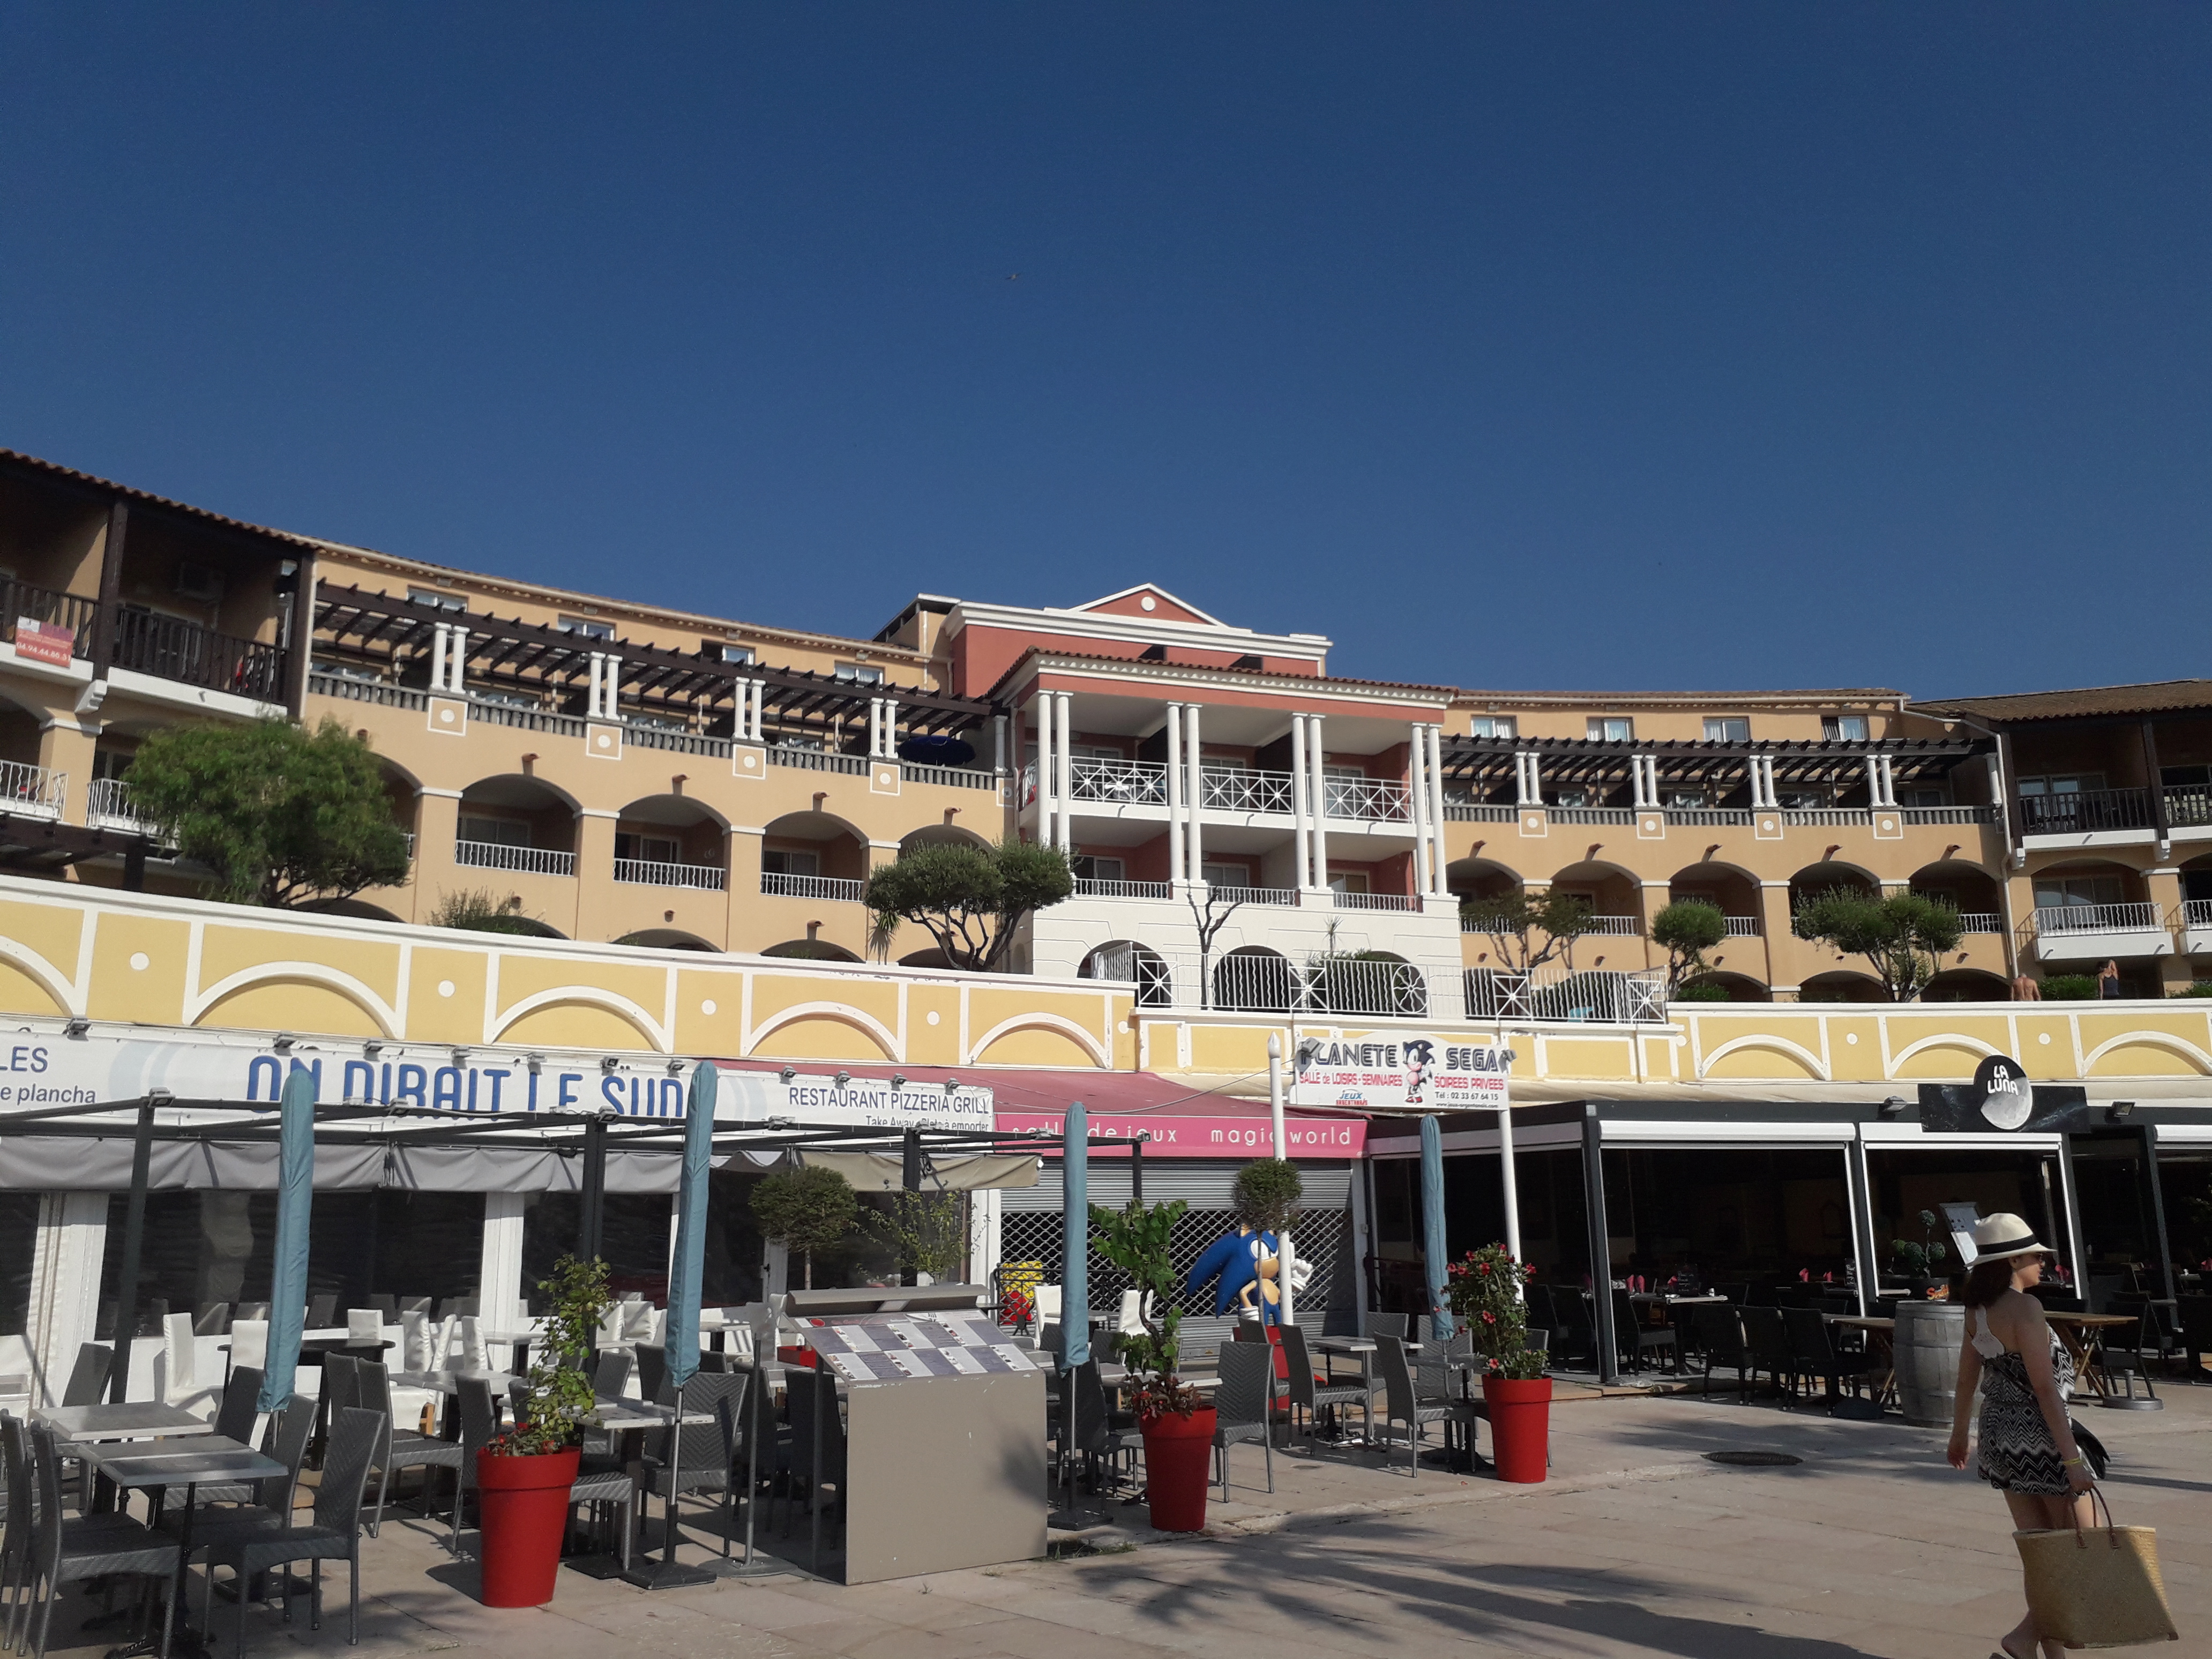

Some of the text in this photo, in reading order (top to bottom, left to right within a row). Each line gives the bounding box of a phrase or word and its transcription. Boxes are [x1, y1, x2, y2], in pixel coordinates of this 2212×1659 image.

[1301, 1042, 1499, 1072] LANETE SEGA
[1299, 1072, 1403, 1087] SALLE de LOISIRS SEMINAIRES
[1993, 1065, 2009, 1079] LA
[1434, 1075, 1504, 1090] SOIREES PRIVEES
[1987, 1079, 2019, 1096] LUNA
[17, 1082, 96, 1106] plancha
[789, 1087, 989, 1114] RESTAURANT PIZZERIA GRILL
[1339, 1090, 1363, 1100] JEUX
[1461, 1092, 1469, 1100] 33
[865, 1115, 888, 1126] Take
[890, 1116, 911, 1127] Away
[951, 1120, 989, 1132] emporter
[1289, 1126, 1350, 1145] world
